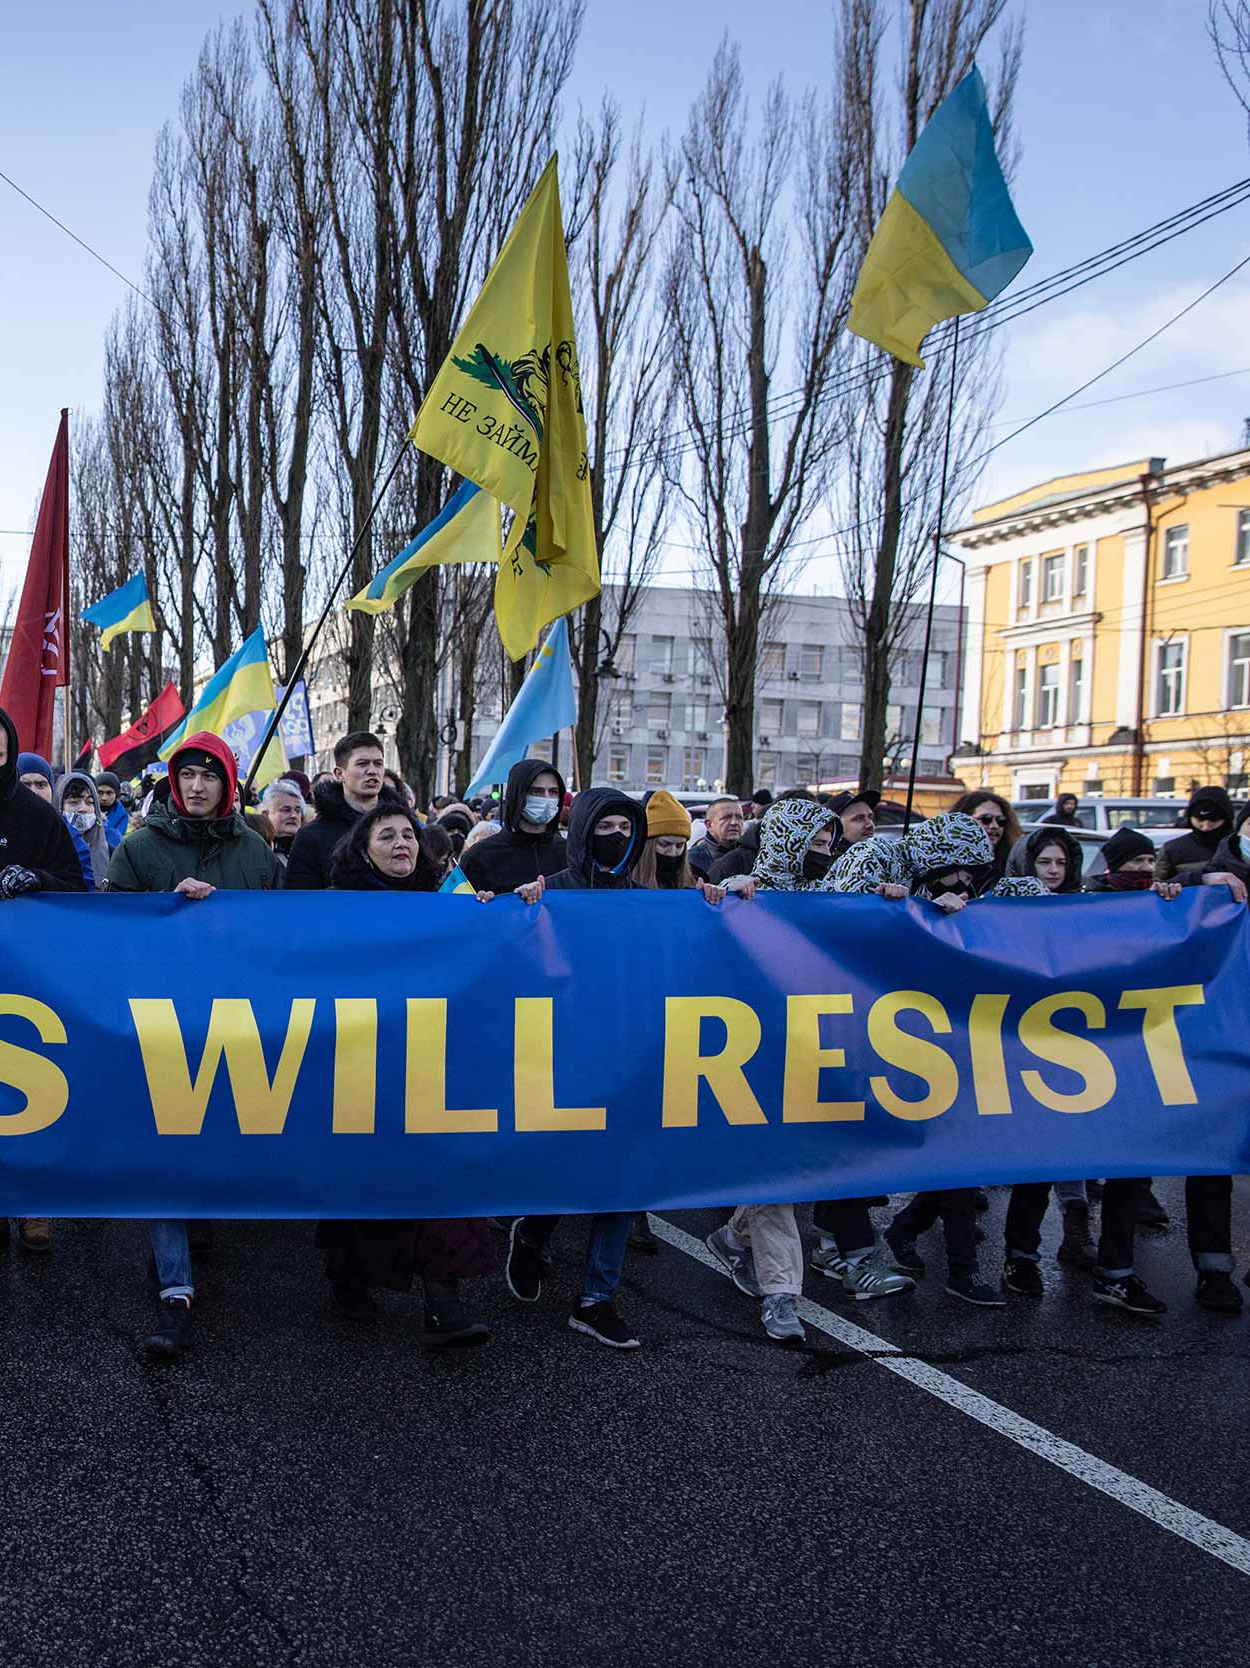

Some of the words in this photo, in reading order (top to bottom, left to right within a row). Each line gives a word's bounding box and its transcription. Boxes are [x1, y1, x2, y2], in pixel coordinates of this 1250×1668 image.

[440, 392, 478, 423] НЕ
[476, 415, 538, 473] ЗАЙМ
[131, 995, 606, 1135] WILL
[663, 985, 1203, 1126] RESIST
